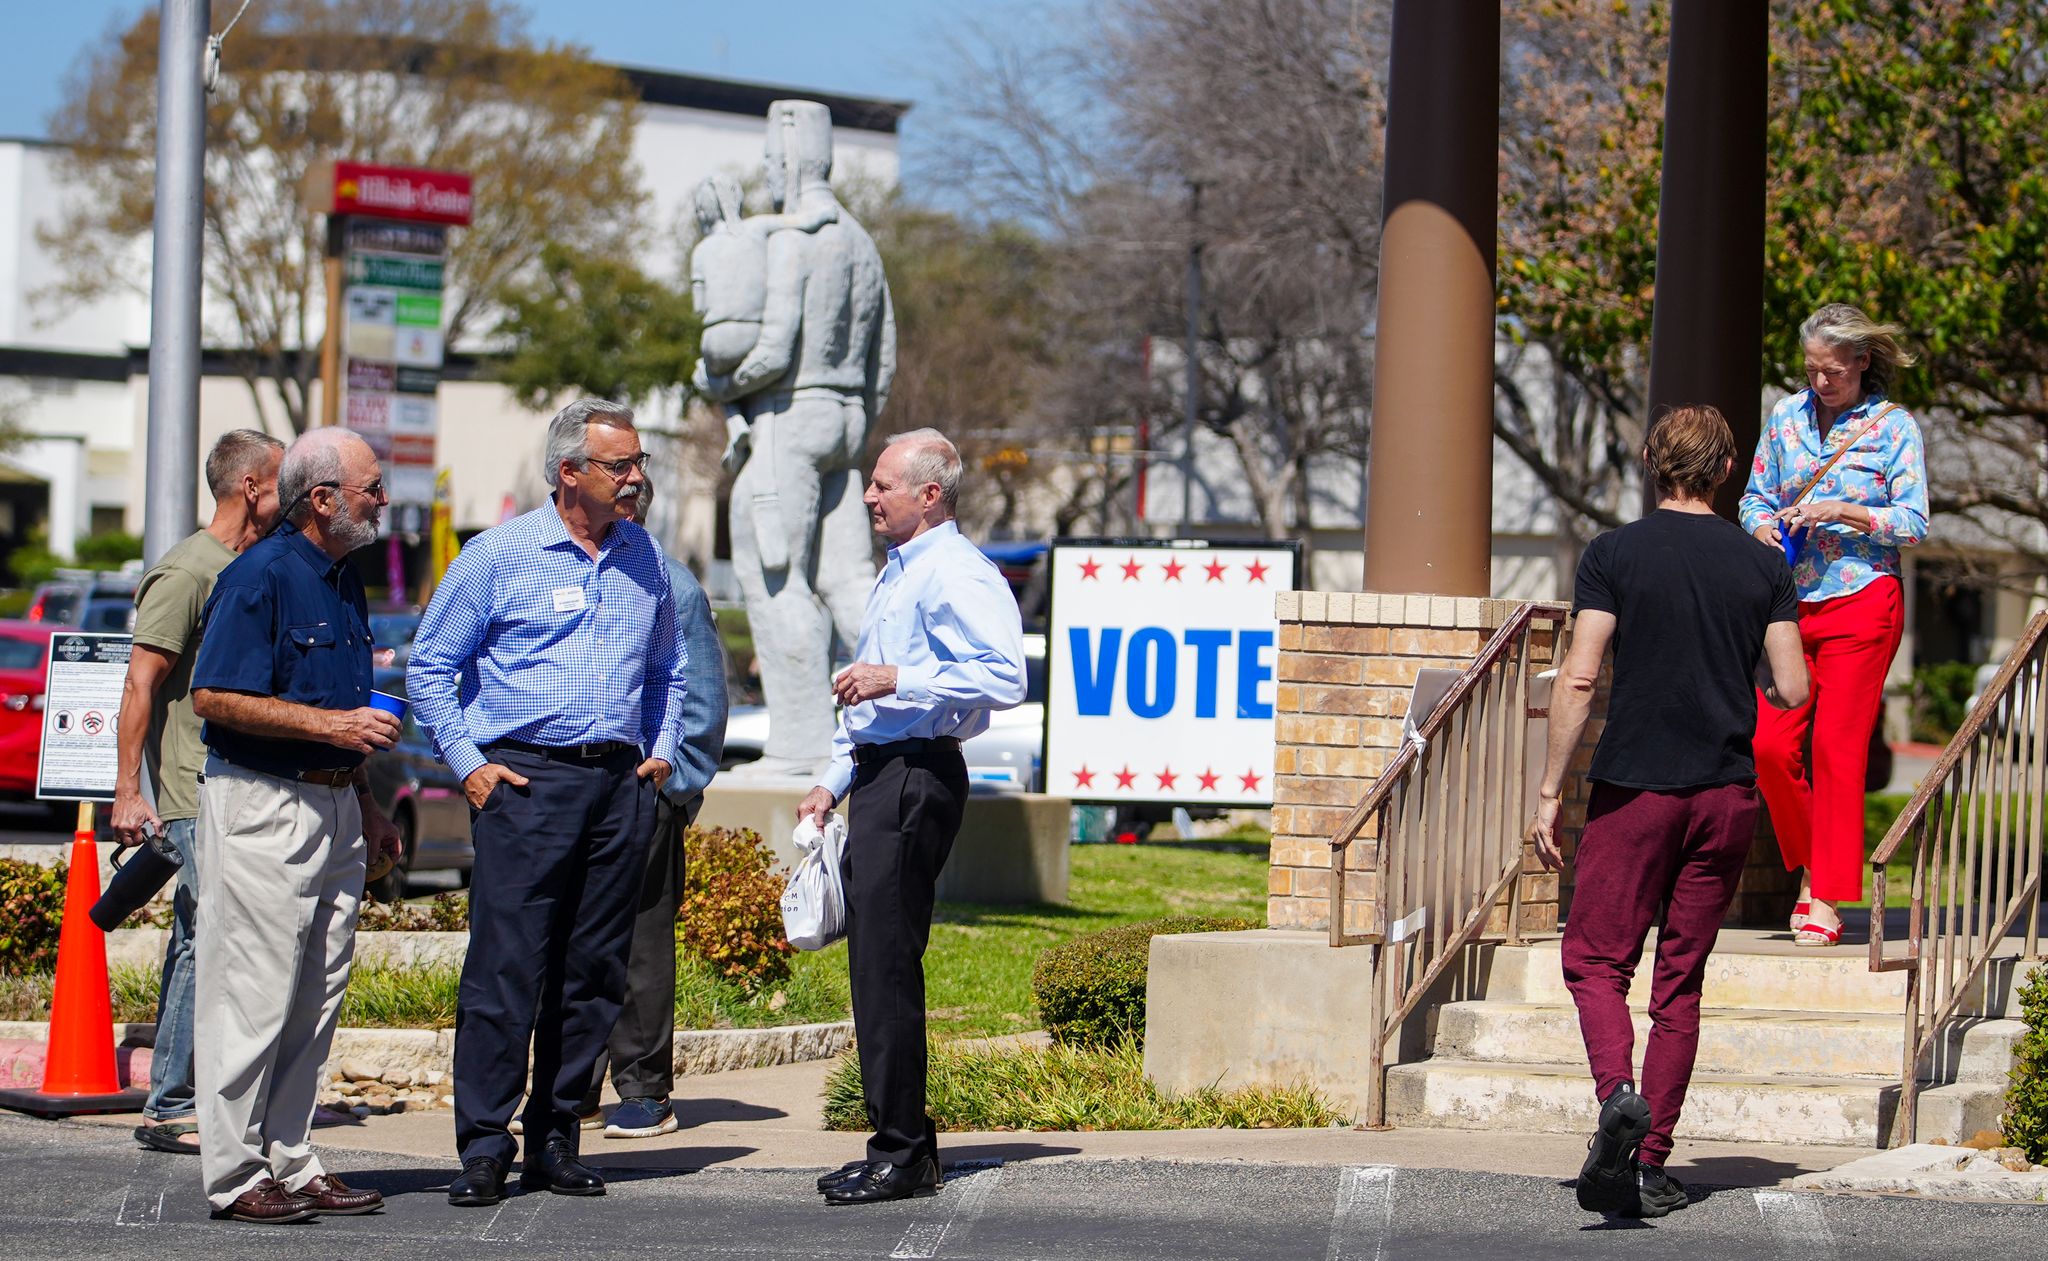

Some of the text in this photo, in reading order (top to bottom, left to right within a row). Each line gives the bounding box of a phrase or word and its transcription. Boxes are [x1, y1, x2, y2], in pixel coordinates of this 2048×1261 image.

[359, 174, 471, 214] Hillside Center
[1069, 626, 1274, 719] VOTE
